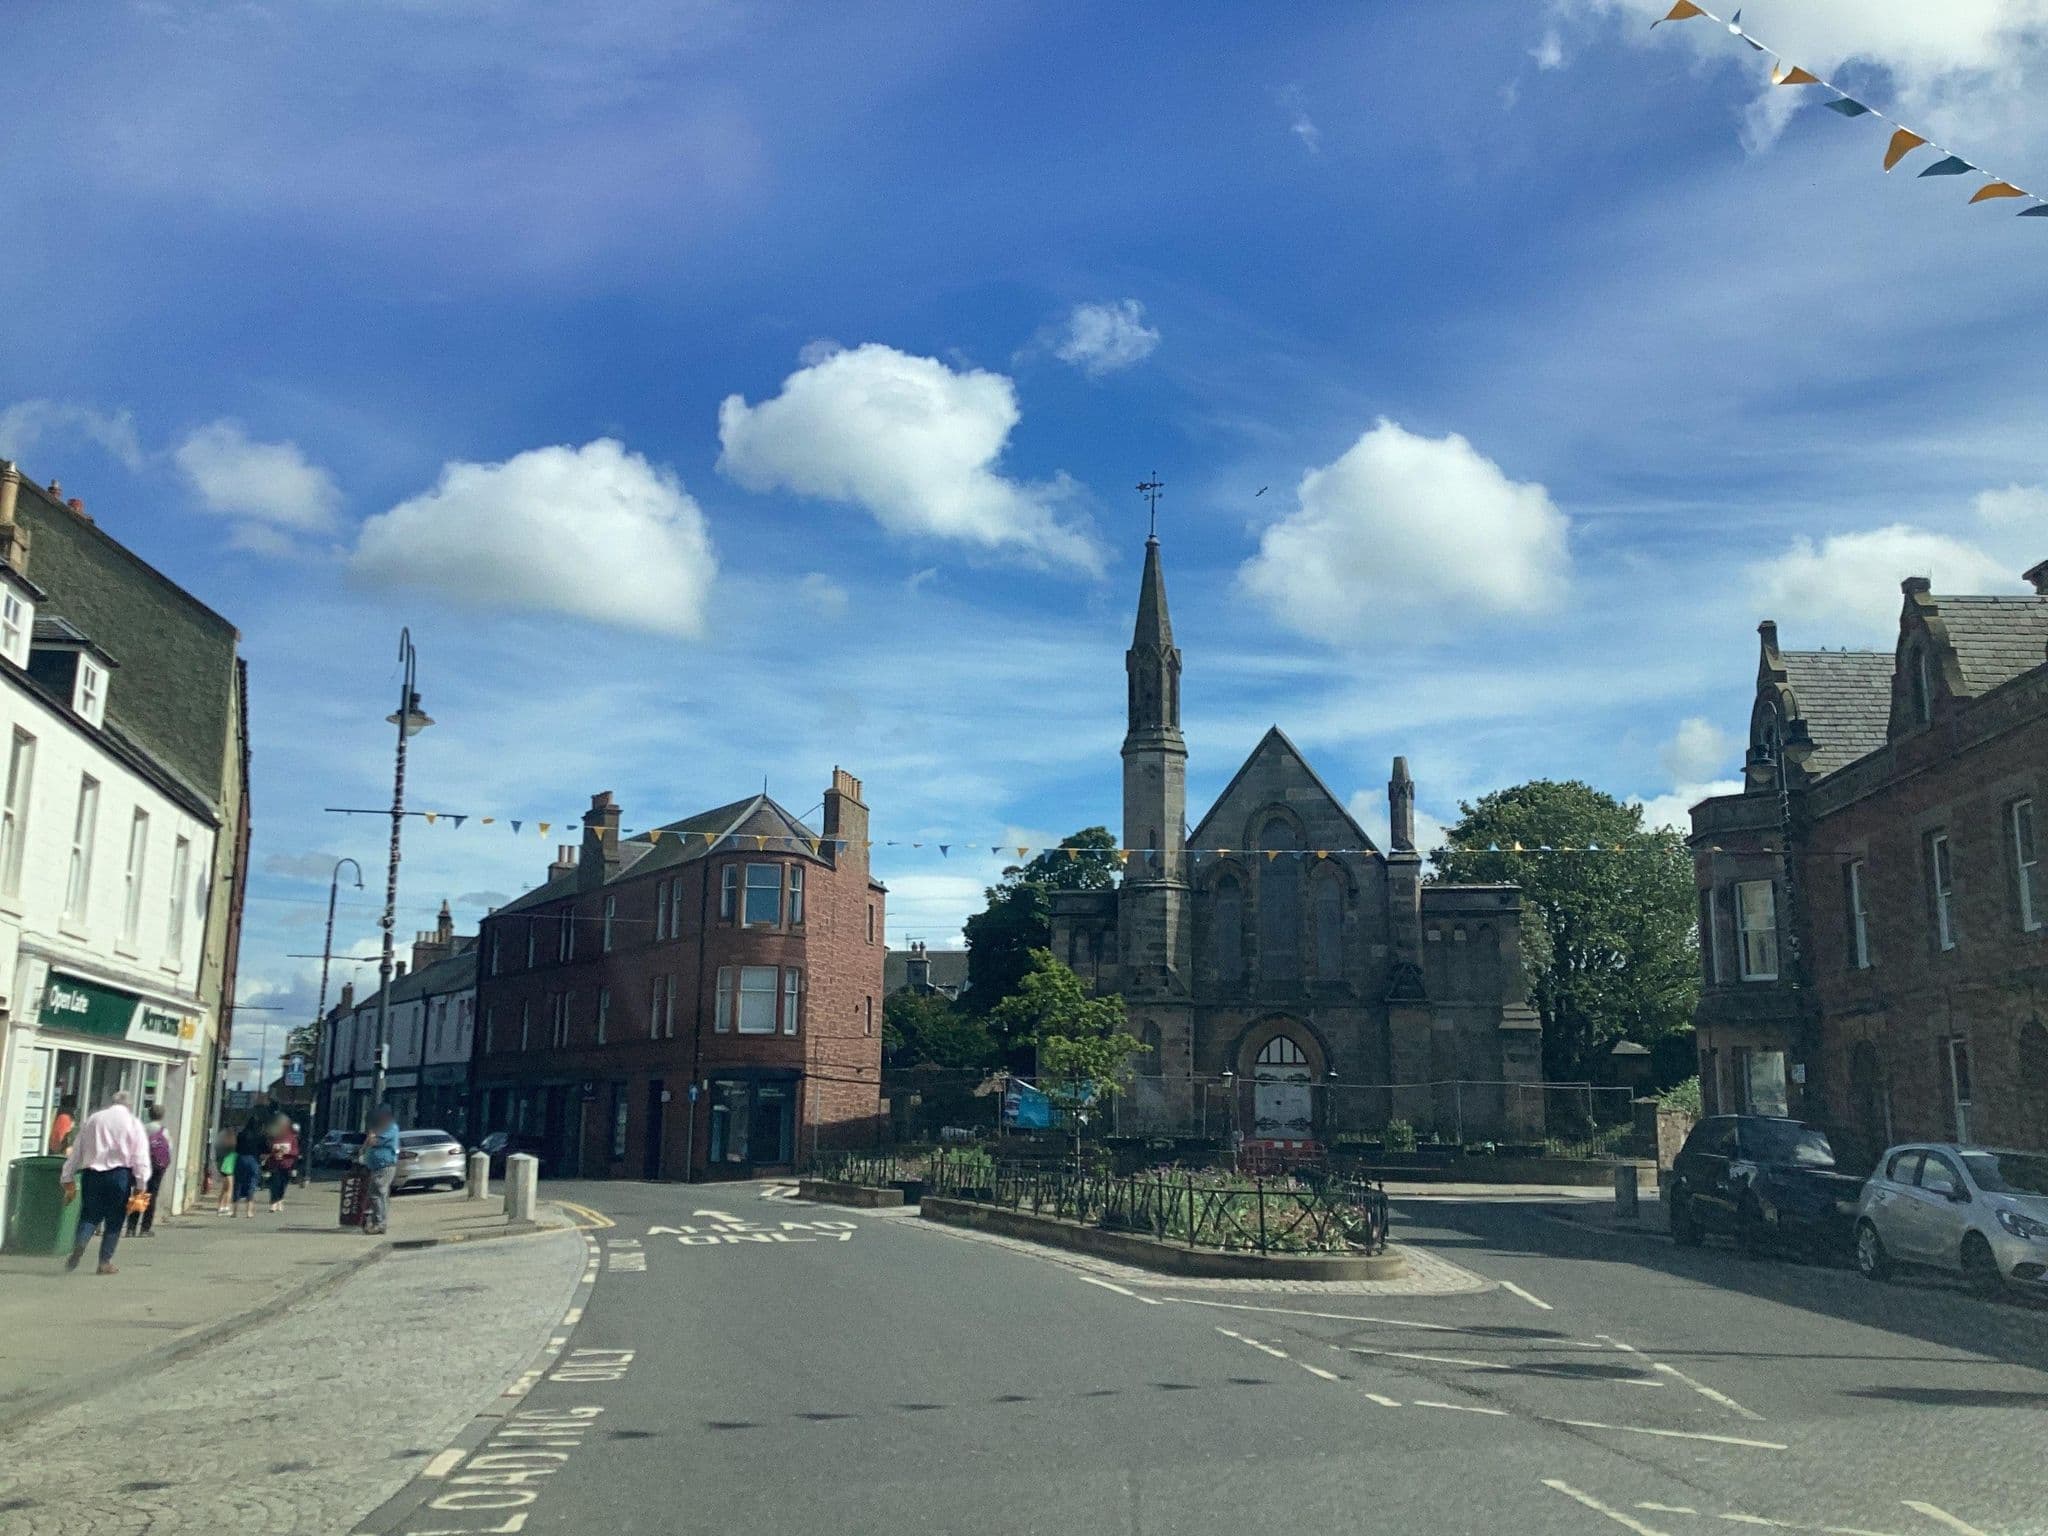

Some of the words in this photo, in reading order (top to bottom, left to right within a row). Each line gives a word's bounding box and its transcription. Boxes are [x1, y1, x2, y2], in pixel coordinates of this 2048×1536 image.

[50, 985, 71, 1014] Open
[71, 990, 89, 1013] Late
[342, 1178, 354, 1215] COSTA
[647, 1221, 858, 1235] AHEAD
[678, 1231, 852, 1246] ONLY
[405, 1407, 605, 1536] LOADING
[549, 1349, 637, 1382] ONLY
